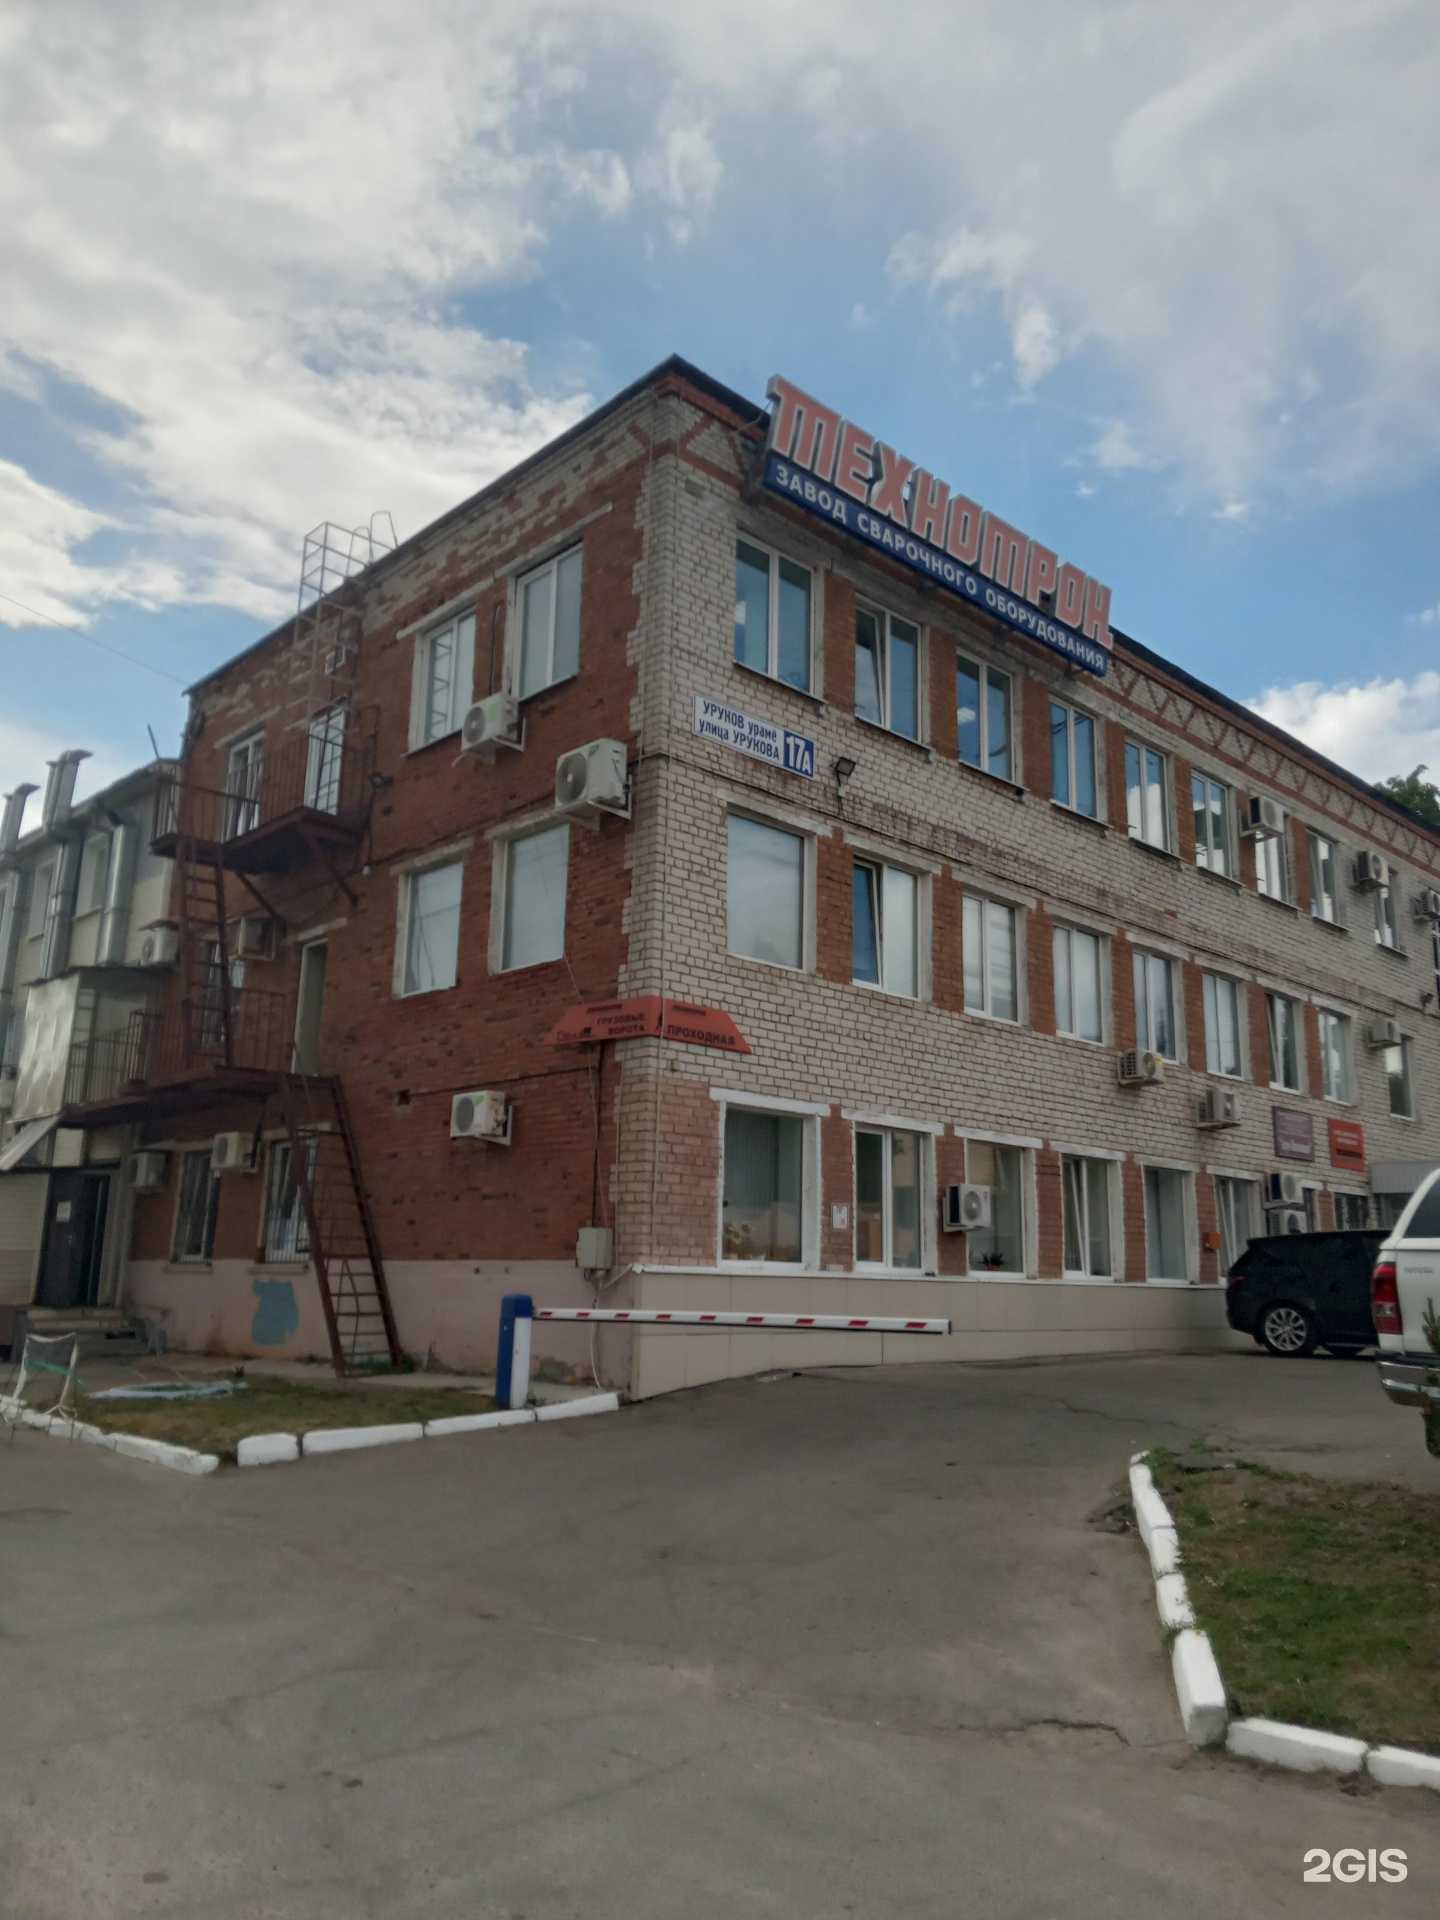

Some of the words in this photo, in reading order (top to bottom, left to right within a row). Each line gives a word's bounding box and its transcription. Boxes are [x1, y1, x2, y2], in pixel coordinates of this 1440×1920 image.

[776, 464, 847, 525] ЗАВОД
[857, 513, 977, 595] СВАРОЧНОГО
[985, 588, 1105, 669] ОБОРУДОВАНИЯ
[703, 700, 745, 729] УРУКОВ
[699, 719, 729, 741] улица
[733, 730, 779, 760] УРУКОВА
[667, 1024, 736, 1045] ПРОХОДНАЯ
